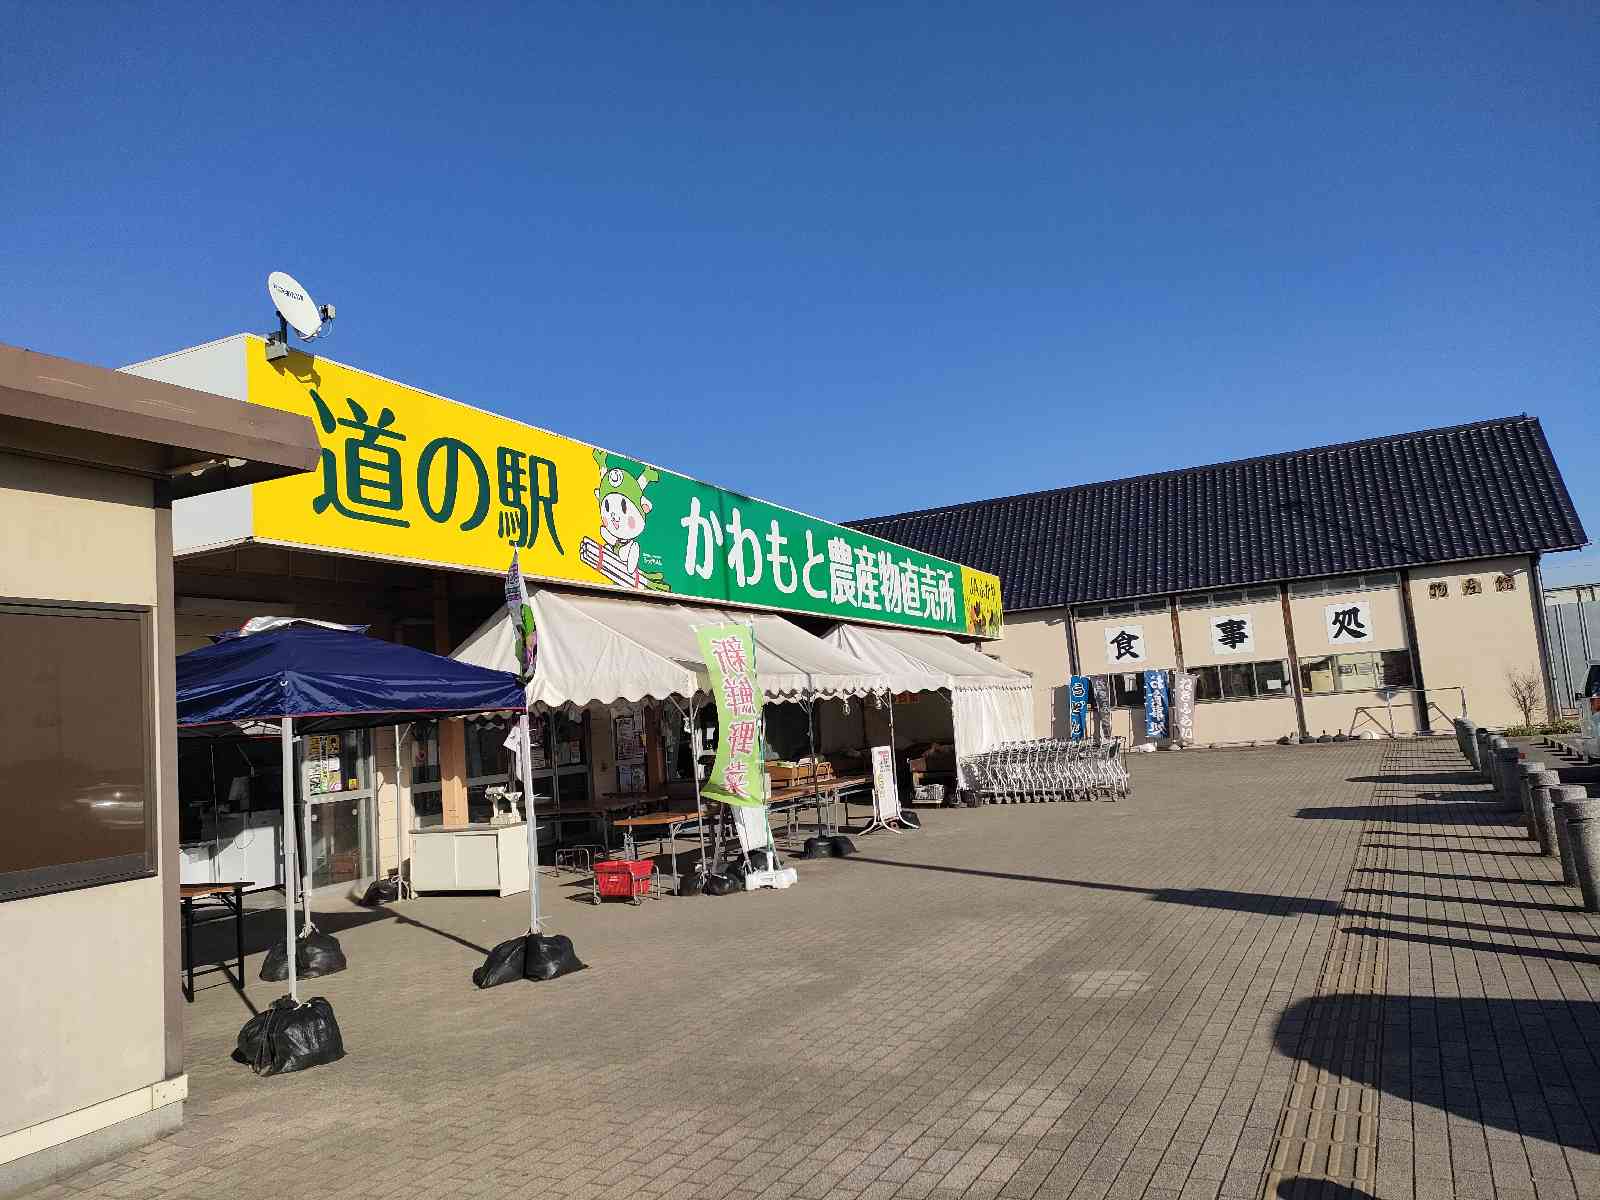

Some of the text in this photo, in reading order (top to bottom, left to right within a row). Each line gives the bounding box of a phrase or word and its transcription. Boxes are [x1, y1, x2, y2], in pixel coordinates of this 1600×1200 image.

[309, 388, 565, 556] 道の駅
[680, 496, 957, 623] かわもと農産物直売所
